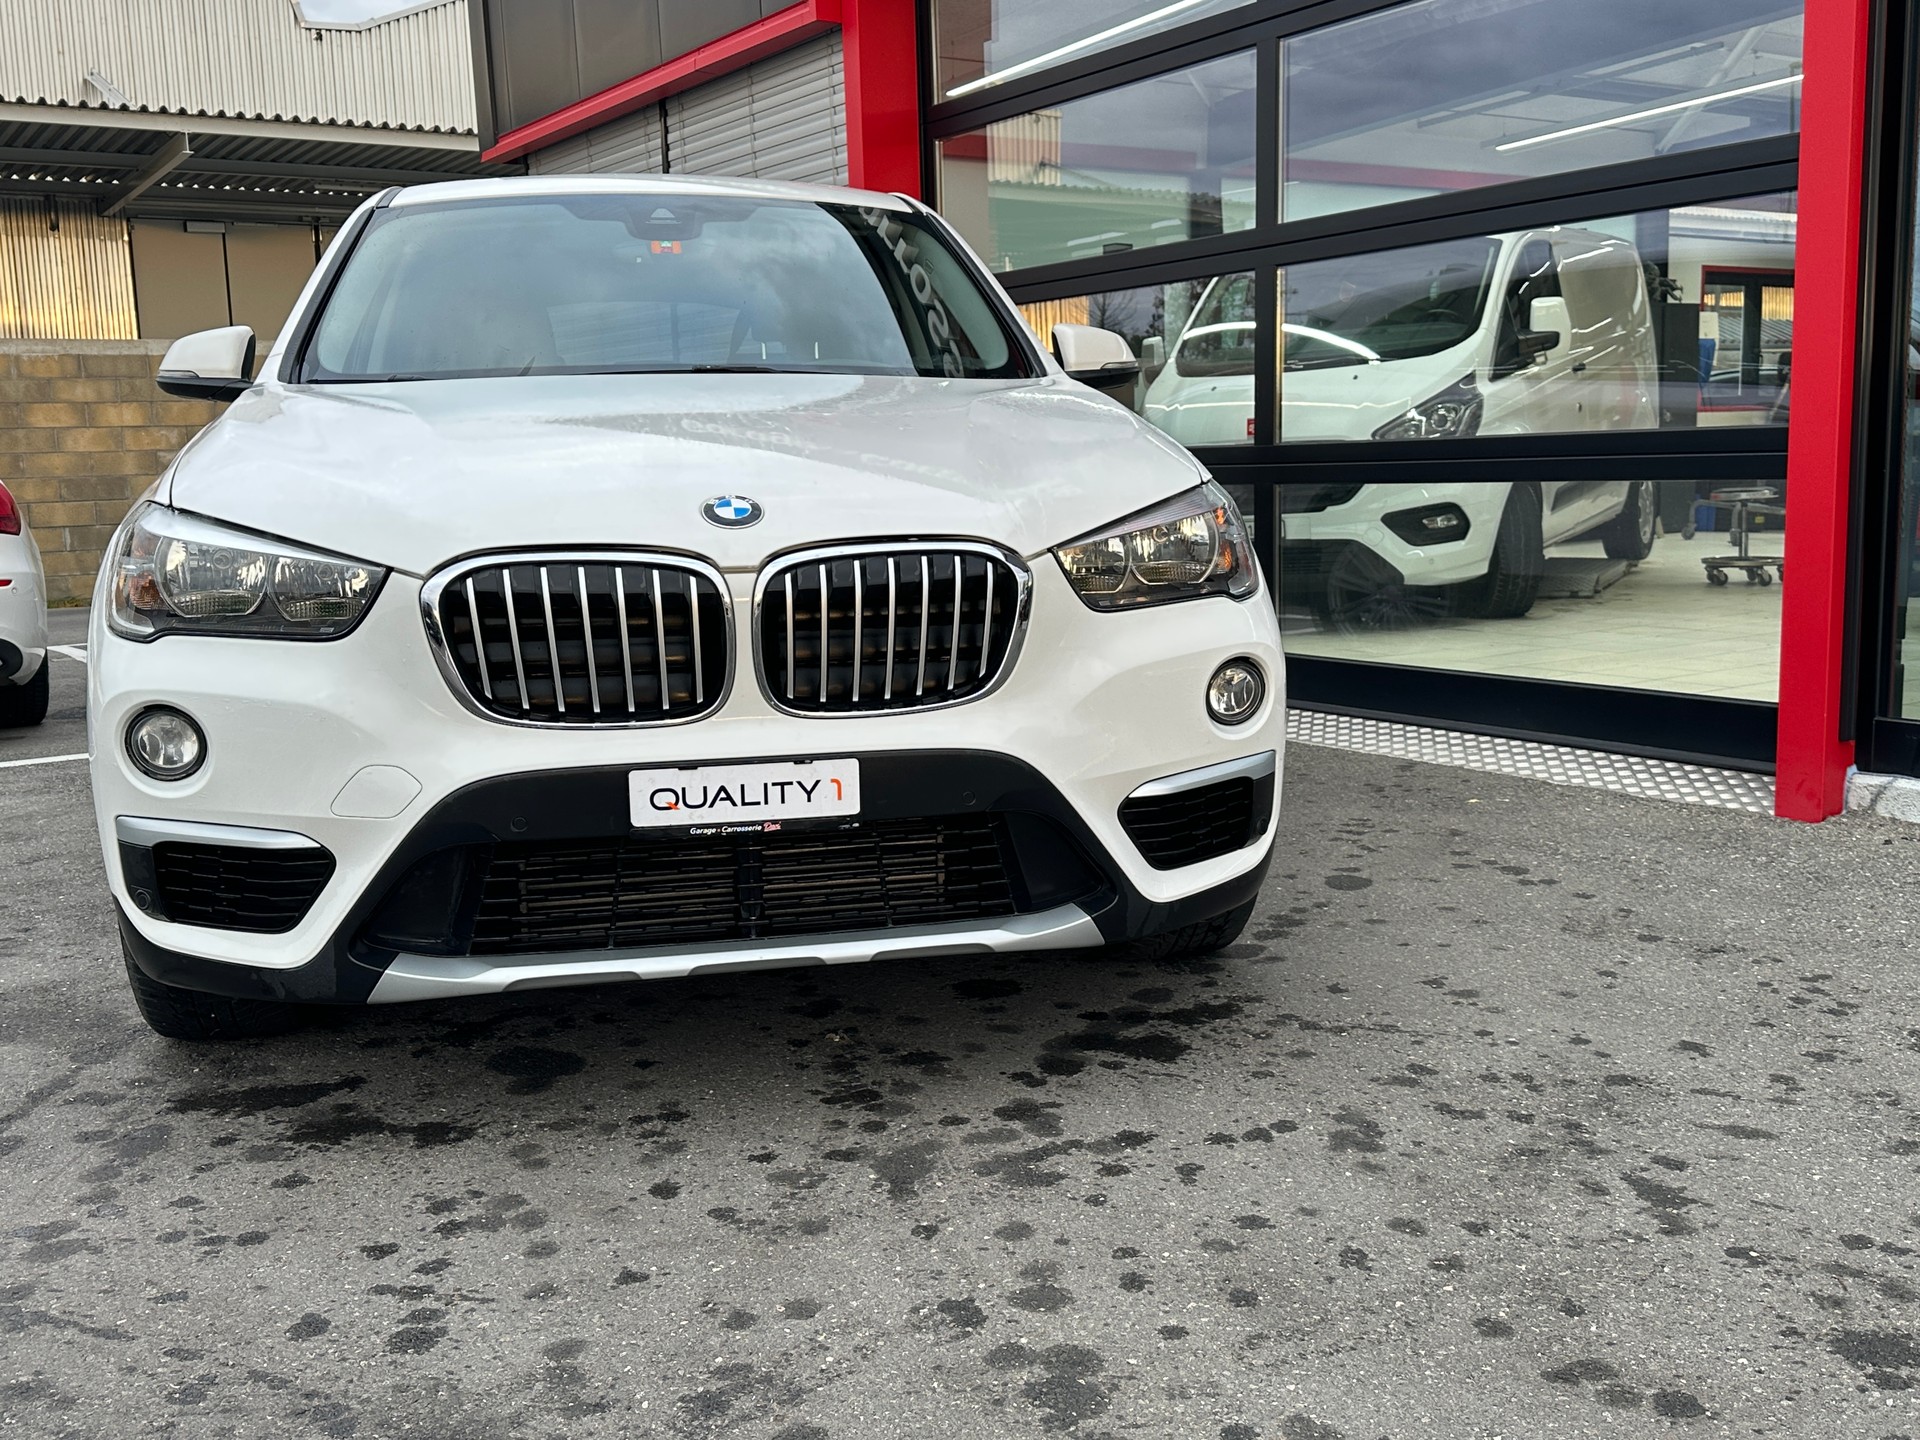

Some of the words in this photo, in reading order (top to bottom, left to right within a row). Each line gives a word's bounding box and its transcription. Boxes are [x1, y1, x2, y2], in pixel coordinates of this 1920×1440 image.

[649, 779, 822, 810] QUALITY
[830, 778, 842, 801] 1
[689, 827, 717, 836] Garage
[721, 823, 762, 833] Carrosserie
